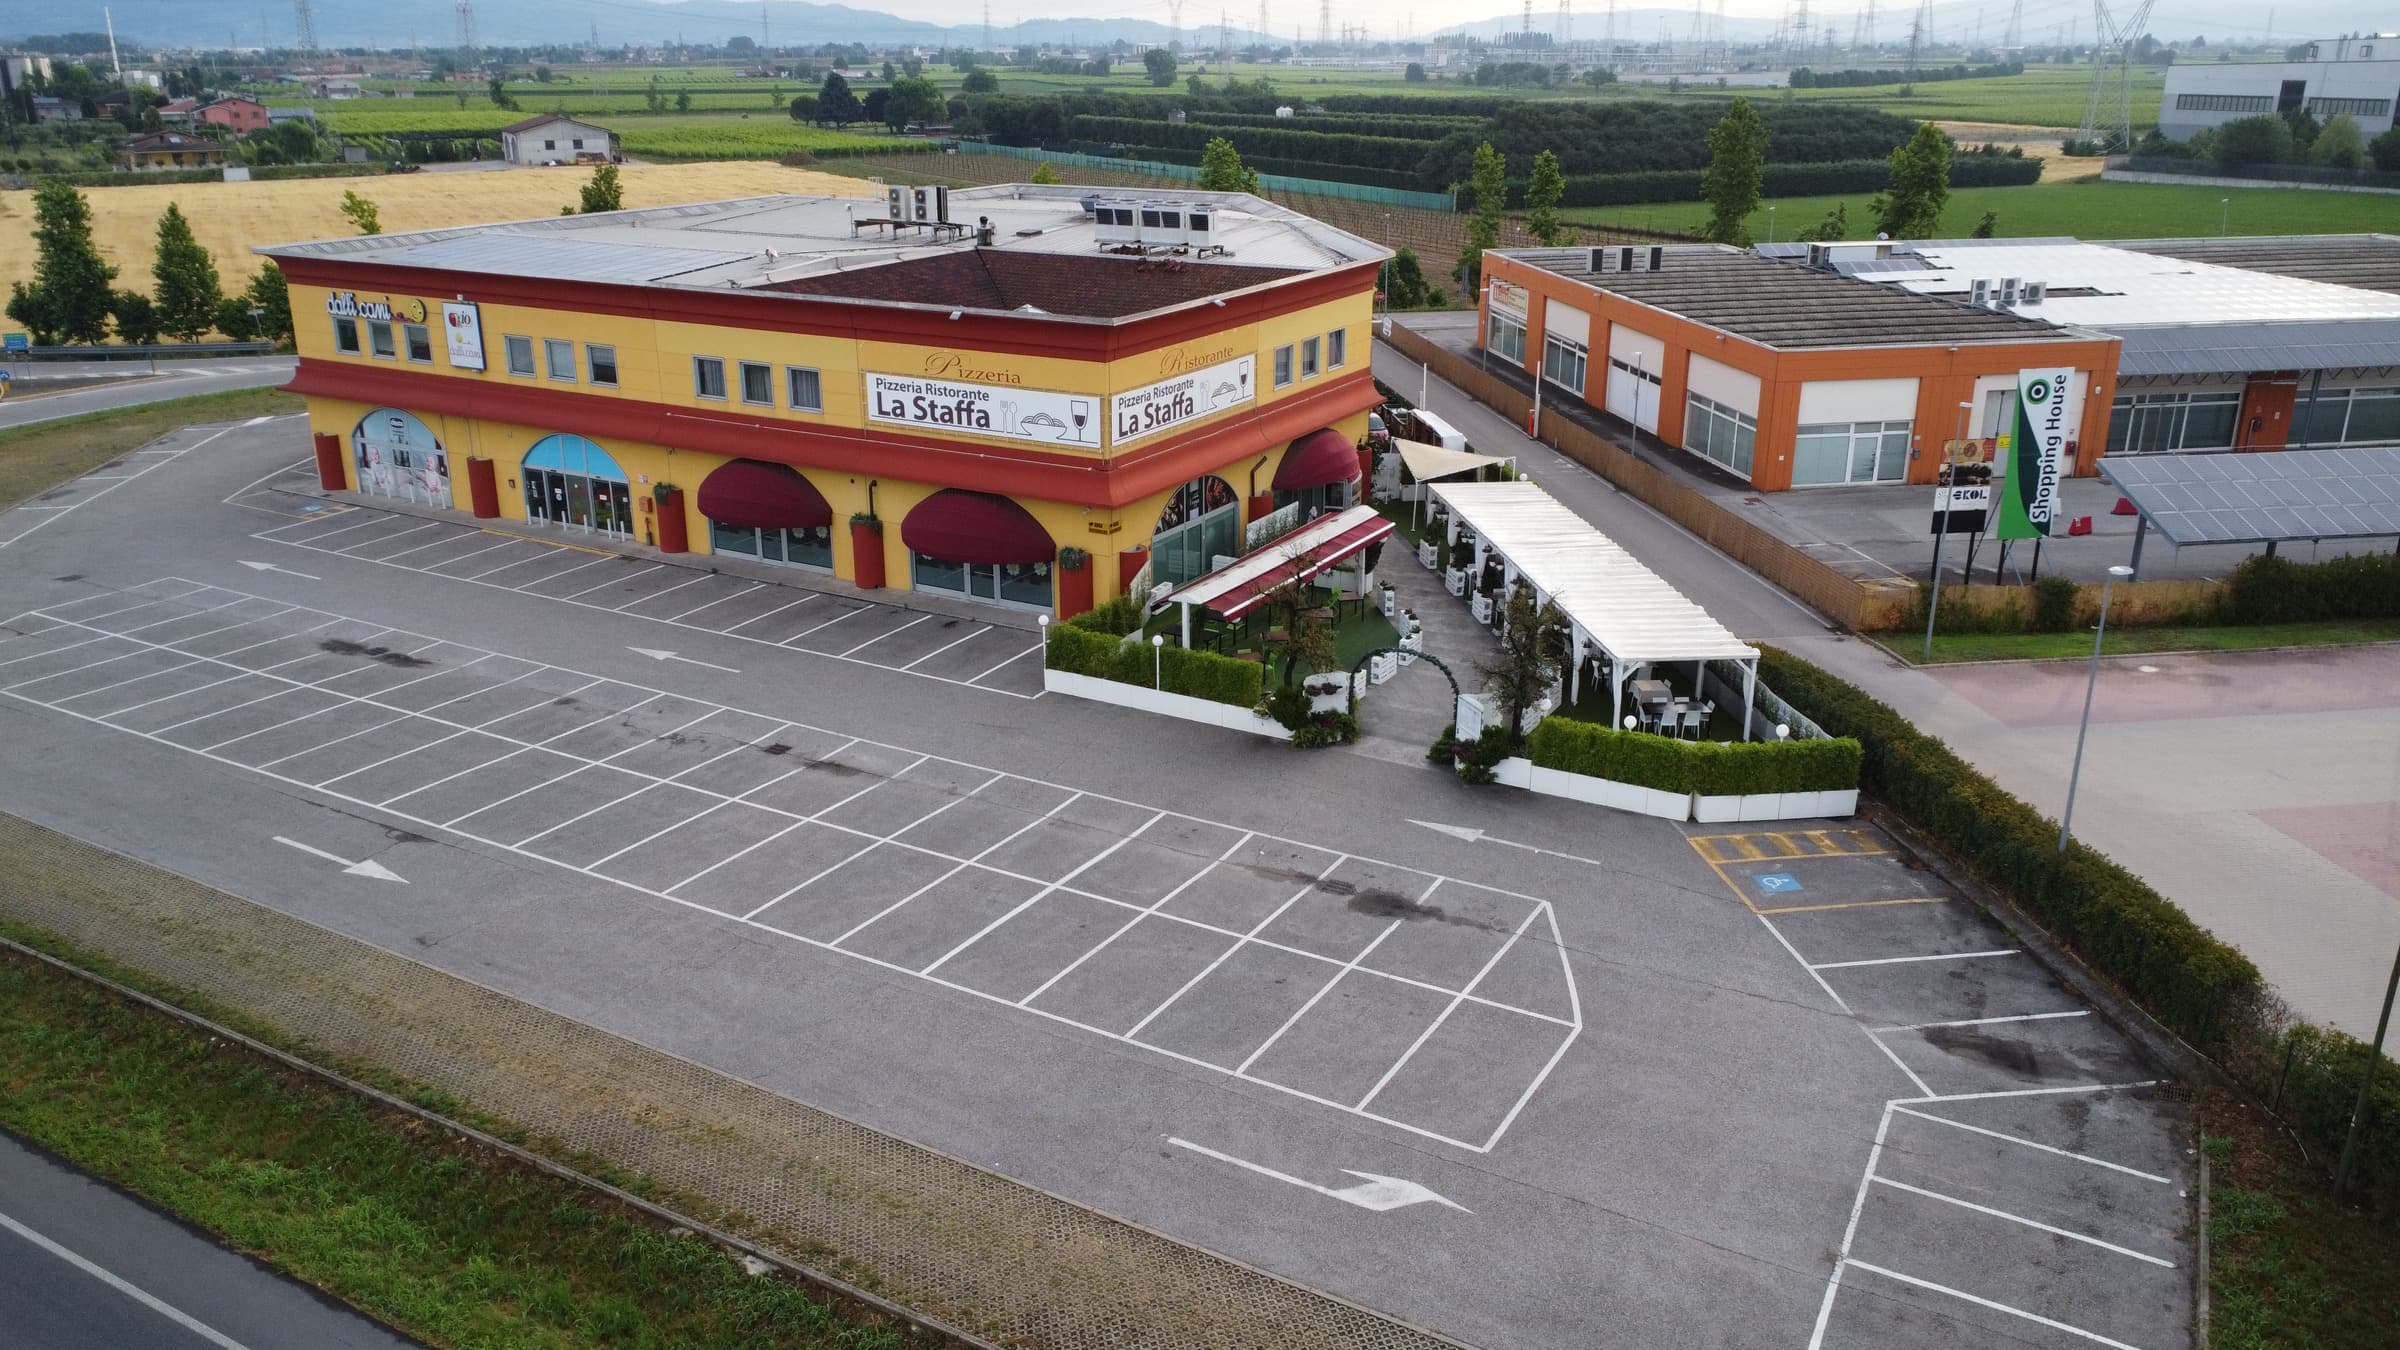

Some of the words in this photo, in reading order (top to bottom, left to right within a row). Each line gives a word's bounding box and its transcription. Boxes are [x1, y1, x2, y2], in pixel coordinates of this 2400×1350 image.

[924, 351, 1022, 385] Pizzeria
[1159, 346, 1234, 375] Ristorante
[875, 377, 923, 395] Pizzeria
[925, 383, 990, 402] Ristorante
[1118, 390, 1151, 411] Pizzeria
[1153, 378, 1195, 401] Ristorante
[2045, 374, 2067, 431] House
[876, 391, 906, 419] La
[912, 395, 991, 429] Staffa
[1118, 412, 1139, 438] La
[1144, 391, 1194, 429] Staffa
[2032, 435, 2063, 521] Shopping
